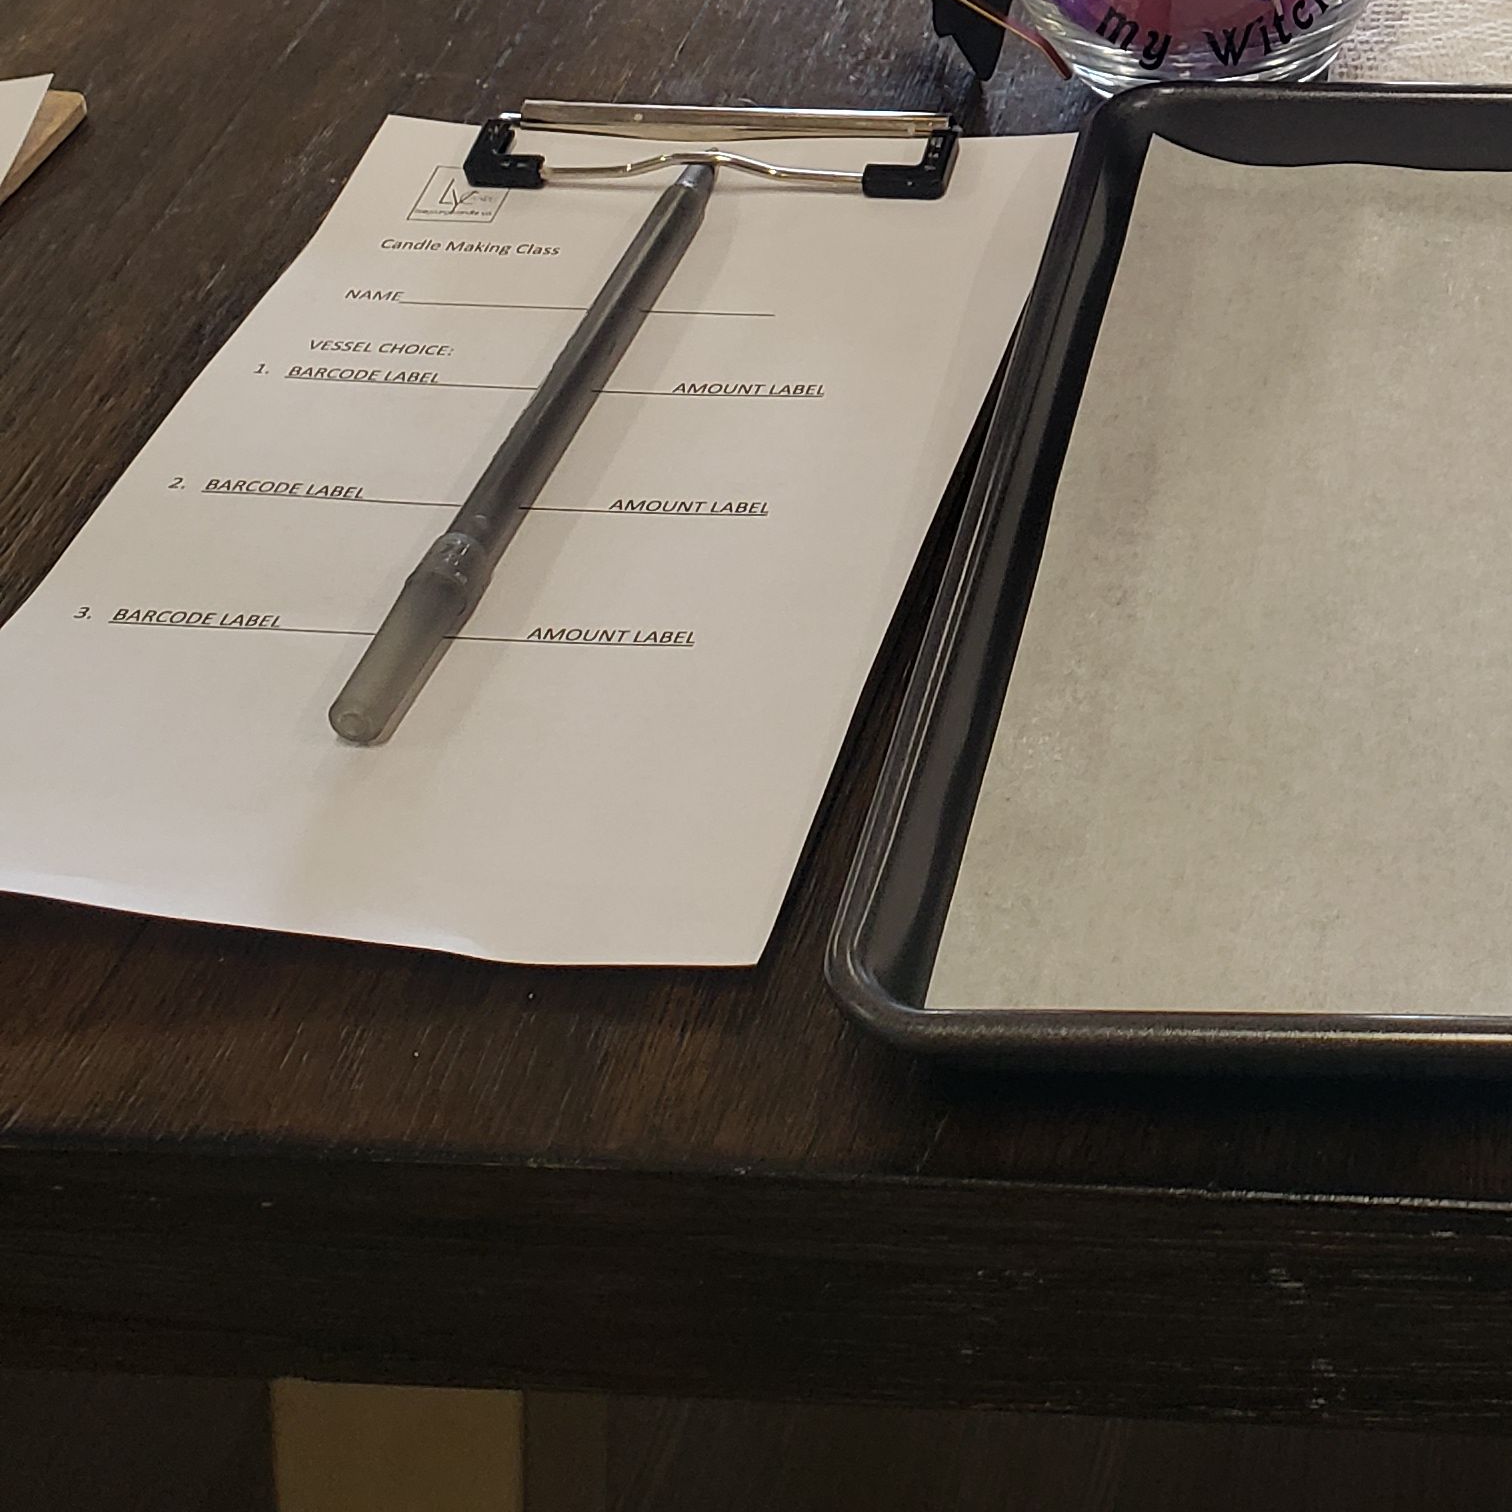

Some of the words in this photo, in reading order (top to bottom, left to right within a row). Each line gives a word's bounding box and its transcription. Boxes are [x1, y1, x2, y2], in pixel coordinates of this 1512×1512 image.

[1096, 4, 1174, 71] my
[380, 238, 442, 252] Candle
[444, 240, 512, 256] Making
[515, 243, 561, 256] Class
[344, 289, 406, 302] NAME
[308, 339, 373, 354] VESSEL
[378, 342, 455, 357] CHOICE:
[253, 363, 271, 375] 1.
[287, 365, 382, 382] BARCODE
[383, 370, 442, 384] LABEL
[672, 383, 767, 395] AMOUNT
[768, 384, 825, 396] LABEL
[168, 476, 186, 490] 2.
[204, 478, 304, 495] BARCODE
[305, 483, 365, 499] LABEL
[608, 499, 708, 513] AMOUNT
[709, 501, 770, 514] LABEL
[73, 606, 93, 620] 3.
[112, 608, 218, 626] BARCODE
[218, 612, 283, 628] LABEL
[526, 627, 631, 643] AMOUNT
[632, 630, 697, 644] LABEL
